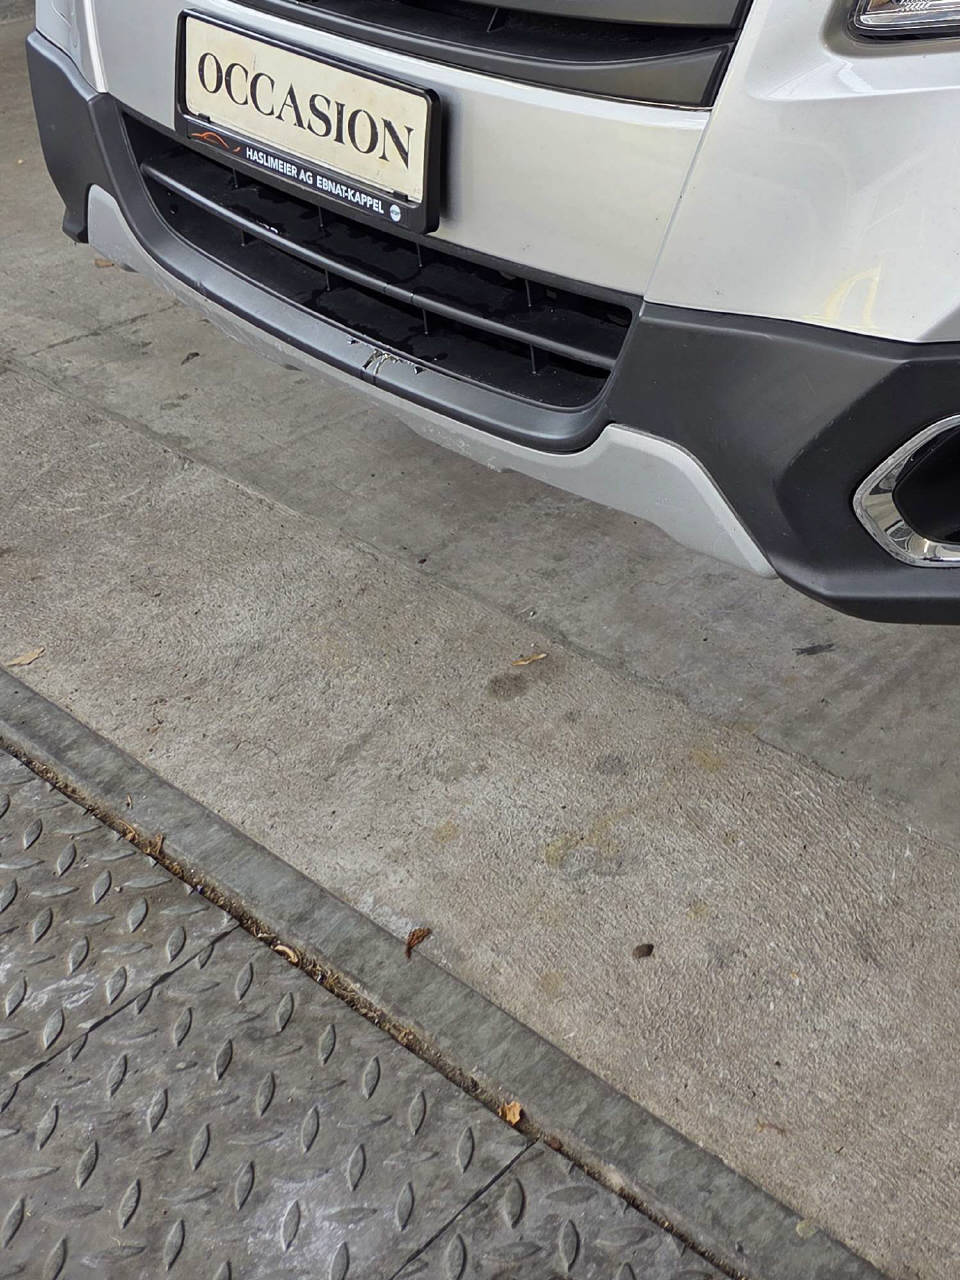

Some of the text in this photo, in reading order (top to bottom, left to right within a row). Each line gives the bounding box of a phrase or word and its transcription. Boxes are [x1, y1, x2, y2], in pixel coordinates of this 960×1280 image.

[198, 52, 414, 169] OCCASION
[246, 146, 298, 178] HASLIMEIER
[298, 168, 314, 185] AG
[316, 175, 385, 214] EBNAT-KAPPEL
